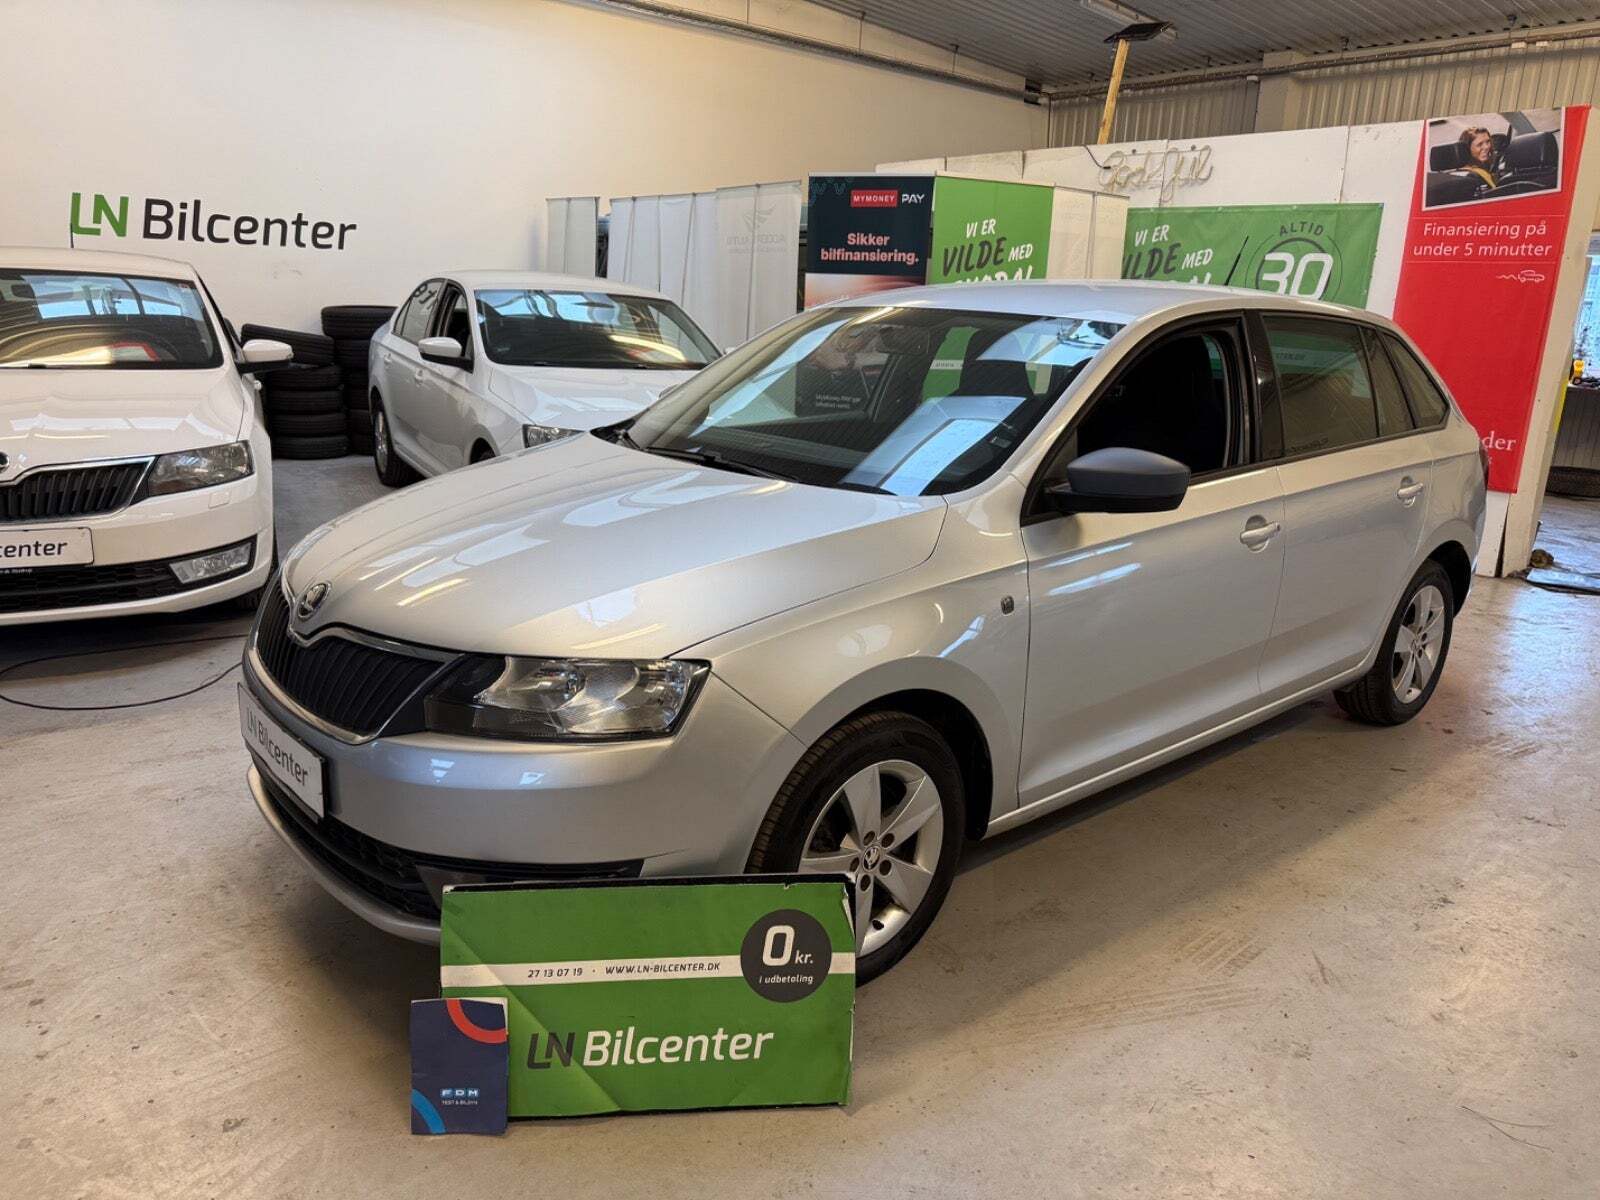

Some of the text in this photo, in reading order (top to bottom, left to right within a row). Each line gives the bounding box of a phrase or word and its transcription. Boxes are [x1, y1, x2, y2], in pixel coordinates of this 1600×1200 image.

[853, 193, 925, 204] MYMONEY PAY
[71, 192, 357, 250] LN Bilcenter
[966, 218, 997, 239] VI ER
[1280, 221, 1324, 237] ALTID
[1423, 220, 1547, 240] Finansiering på
[847, 233, 890, 246] Sikker
[1134, 224, 1170, 247] VI ER
[820, 247, 920, 266] bilfinansiering.
[942, 236, 1008, 278] VILDE
[1007, 243, 1034, 263] MED
[1413, 242, 1552, 257] under 5 minutter
[1121, 242, 1181, 280] ILDE
[1181, 248, 1214, 271] MED
[1262, 252, 1334, 300] 30
[1481, 430, 1517, 452] der
[0, 541, 68, 558] enter
[258, 720, 309, 787] Bilcenter
[762, 924, 814, 967] 0 kr.
[528, 962, 721, 978] 27 13 07 19 WWW.LN-BILCENTER.DK
[765, 974, 814, 985] udbetaling
[527, 1026, 775, 1069] LN Bilcenter
